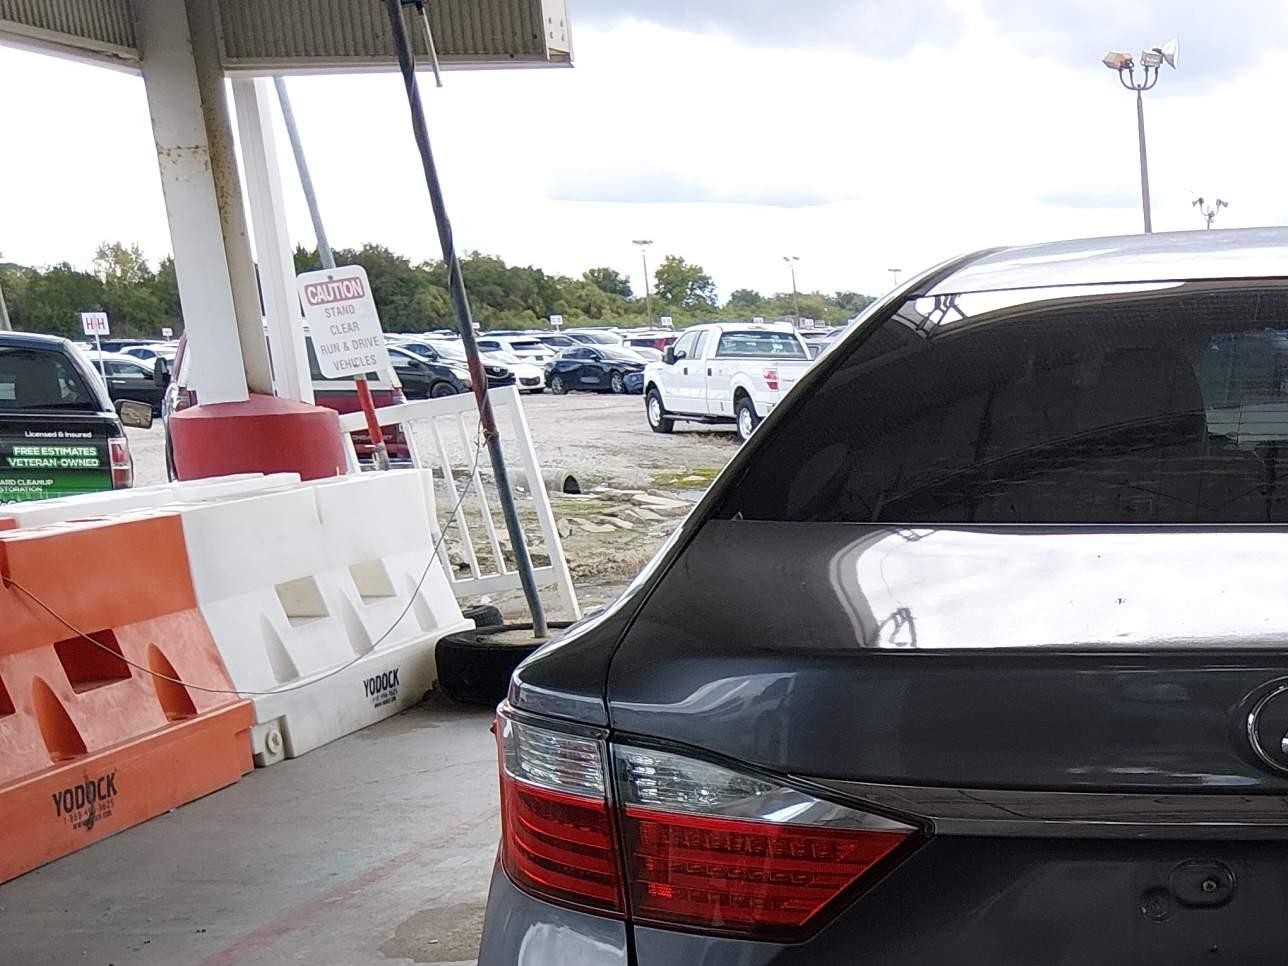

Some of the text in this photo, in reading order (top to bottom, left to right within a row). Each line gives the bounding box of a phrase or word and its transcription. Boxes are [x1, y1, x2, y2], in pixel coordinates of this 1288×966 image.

[306, 279, 364, 304] CAUTION
[324, 304, 355, 318] STAND
[330, 321, 360, 335] CLEAR
[320, 336, 380, 355] RUN & DRIVE
[333, 354, 377, 371] VEHICLES
[24, 430, 57, 438] Licensed
[13, 446, 97, 456] FREE ESTIMATES
[363, 668, 399, 698] YODOCK
[52, 772, 117, 817] YODOCK
